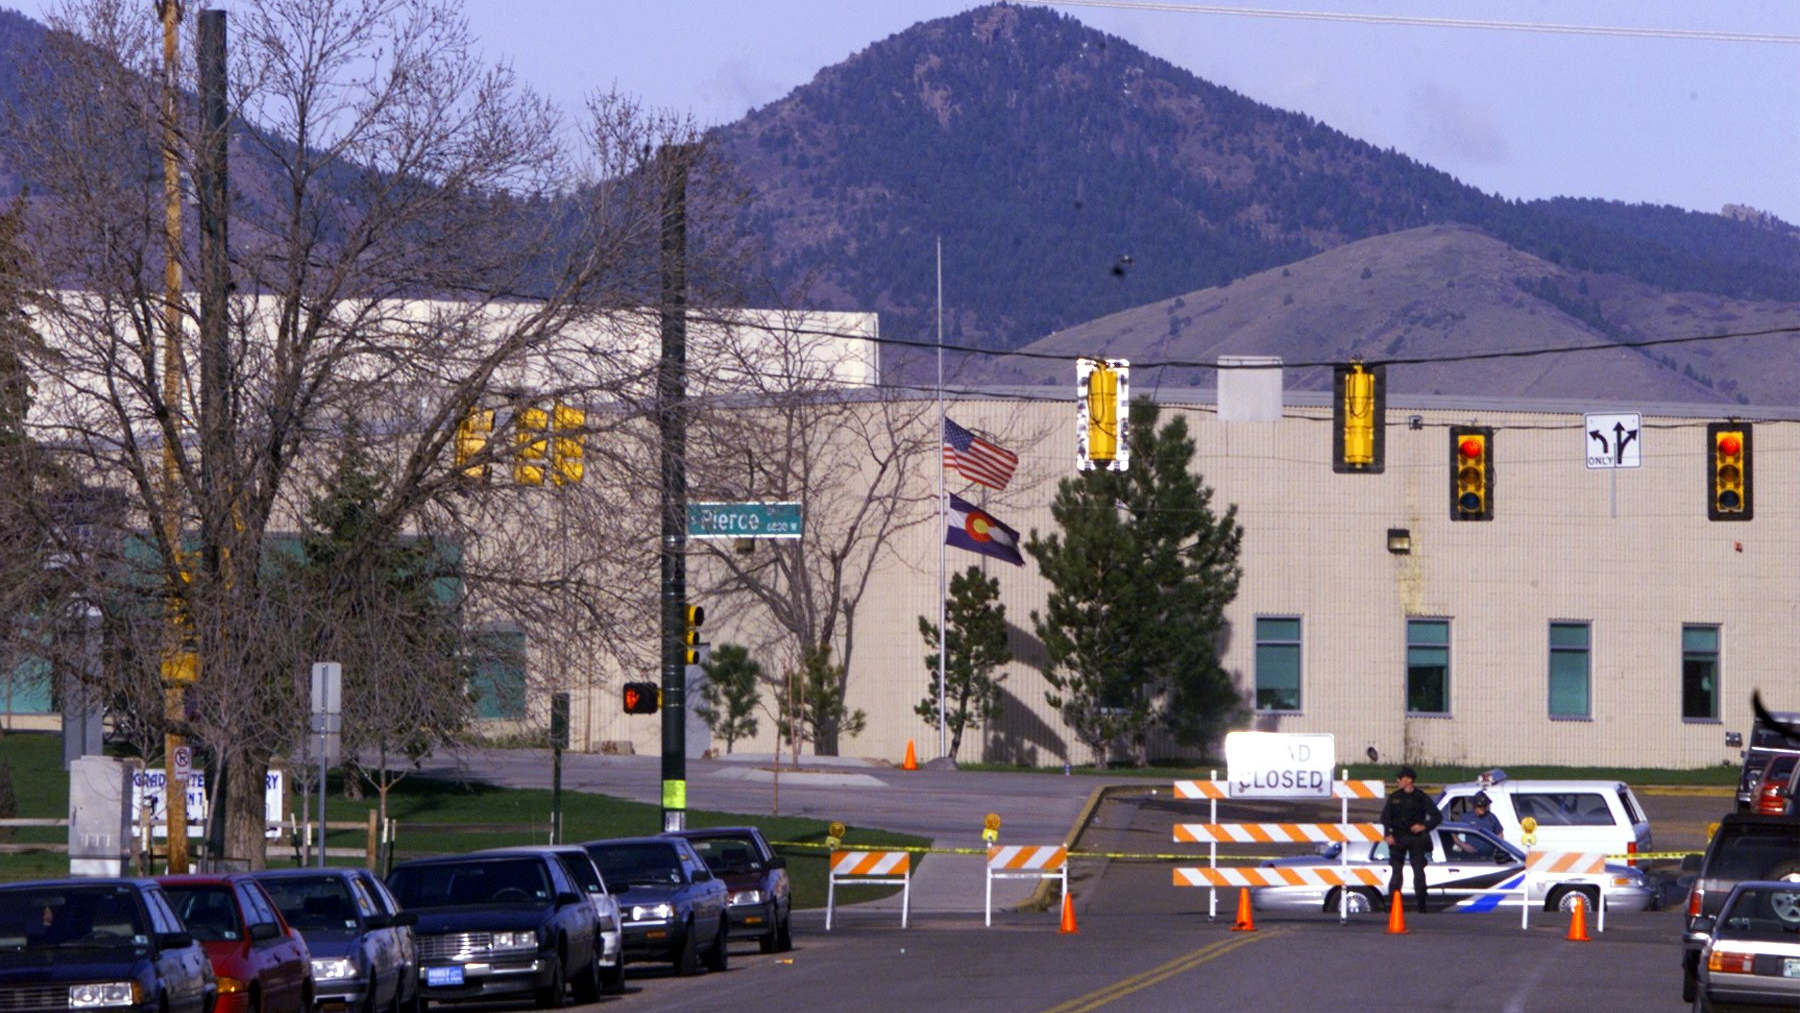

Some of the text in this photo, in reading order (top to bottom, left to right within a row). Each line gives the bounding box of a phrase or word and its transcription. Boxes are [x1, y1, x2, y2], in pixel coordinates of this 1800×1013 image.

[1589, 456, 1613, 465] ONLY
[701, 509, 759, 530] Pierce
[133, 773, 204, 788] GRADTE
